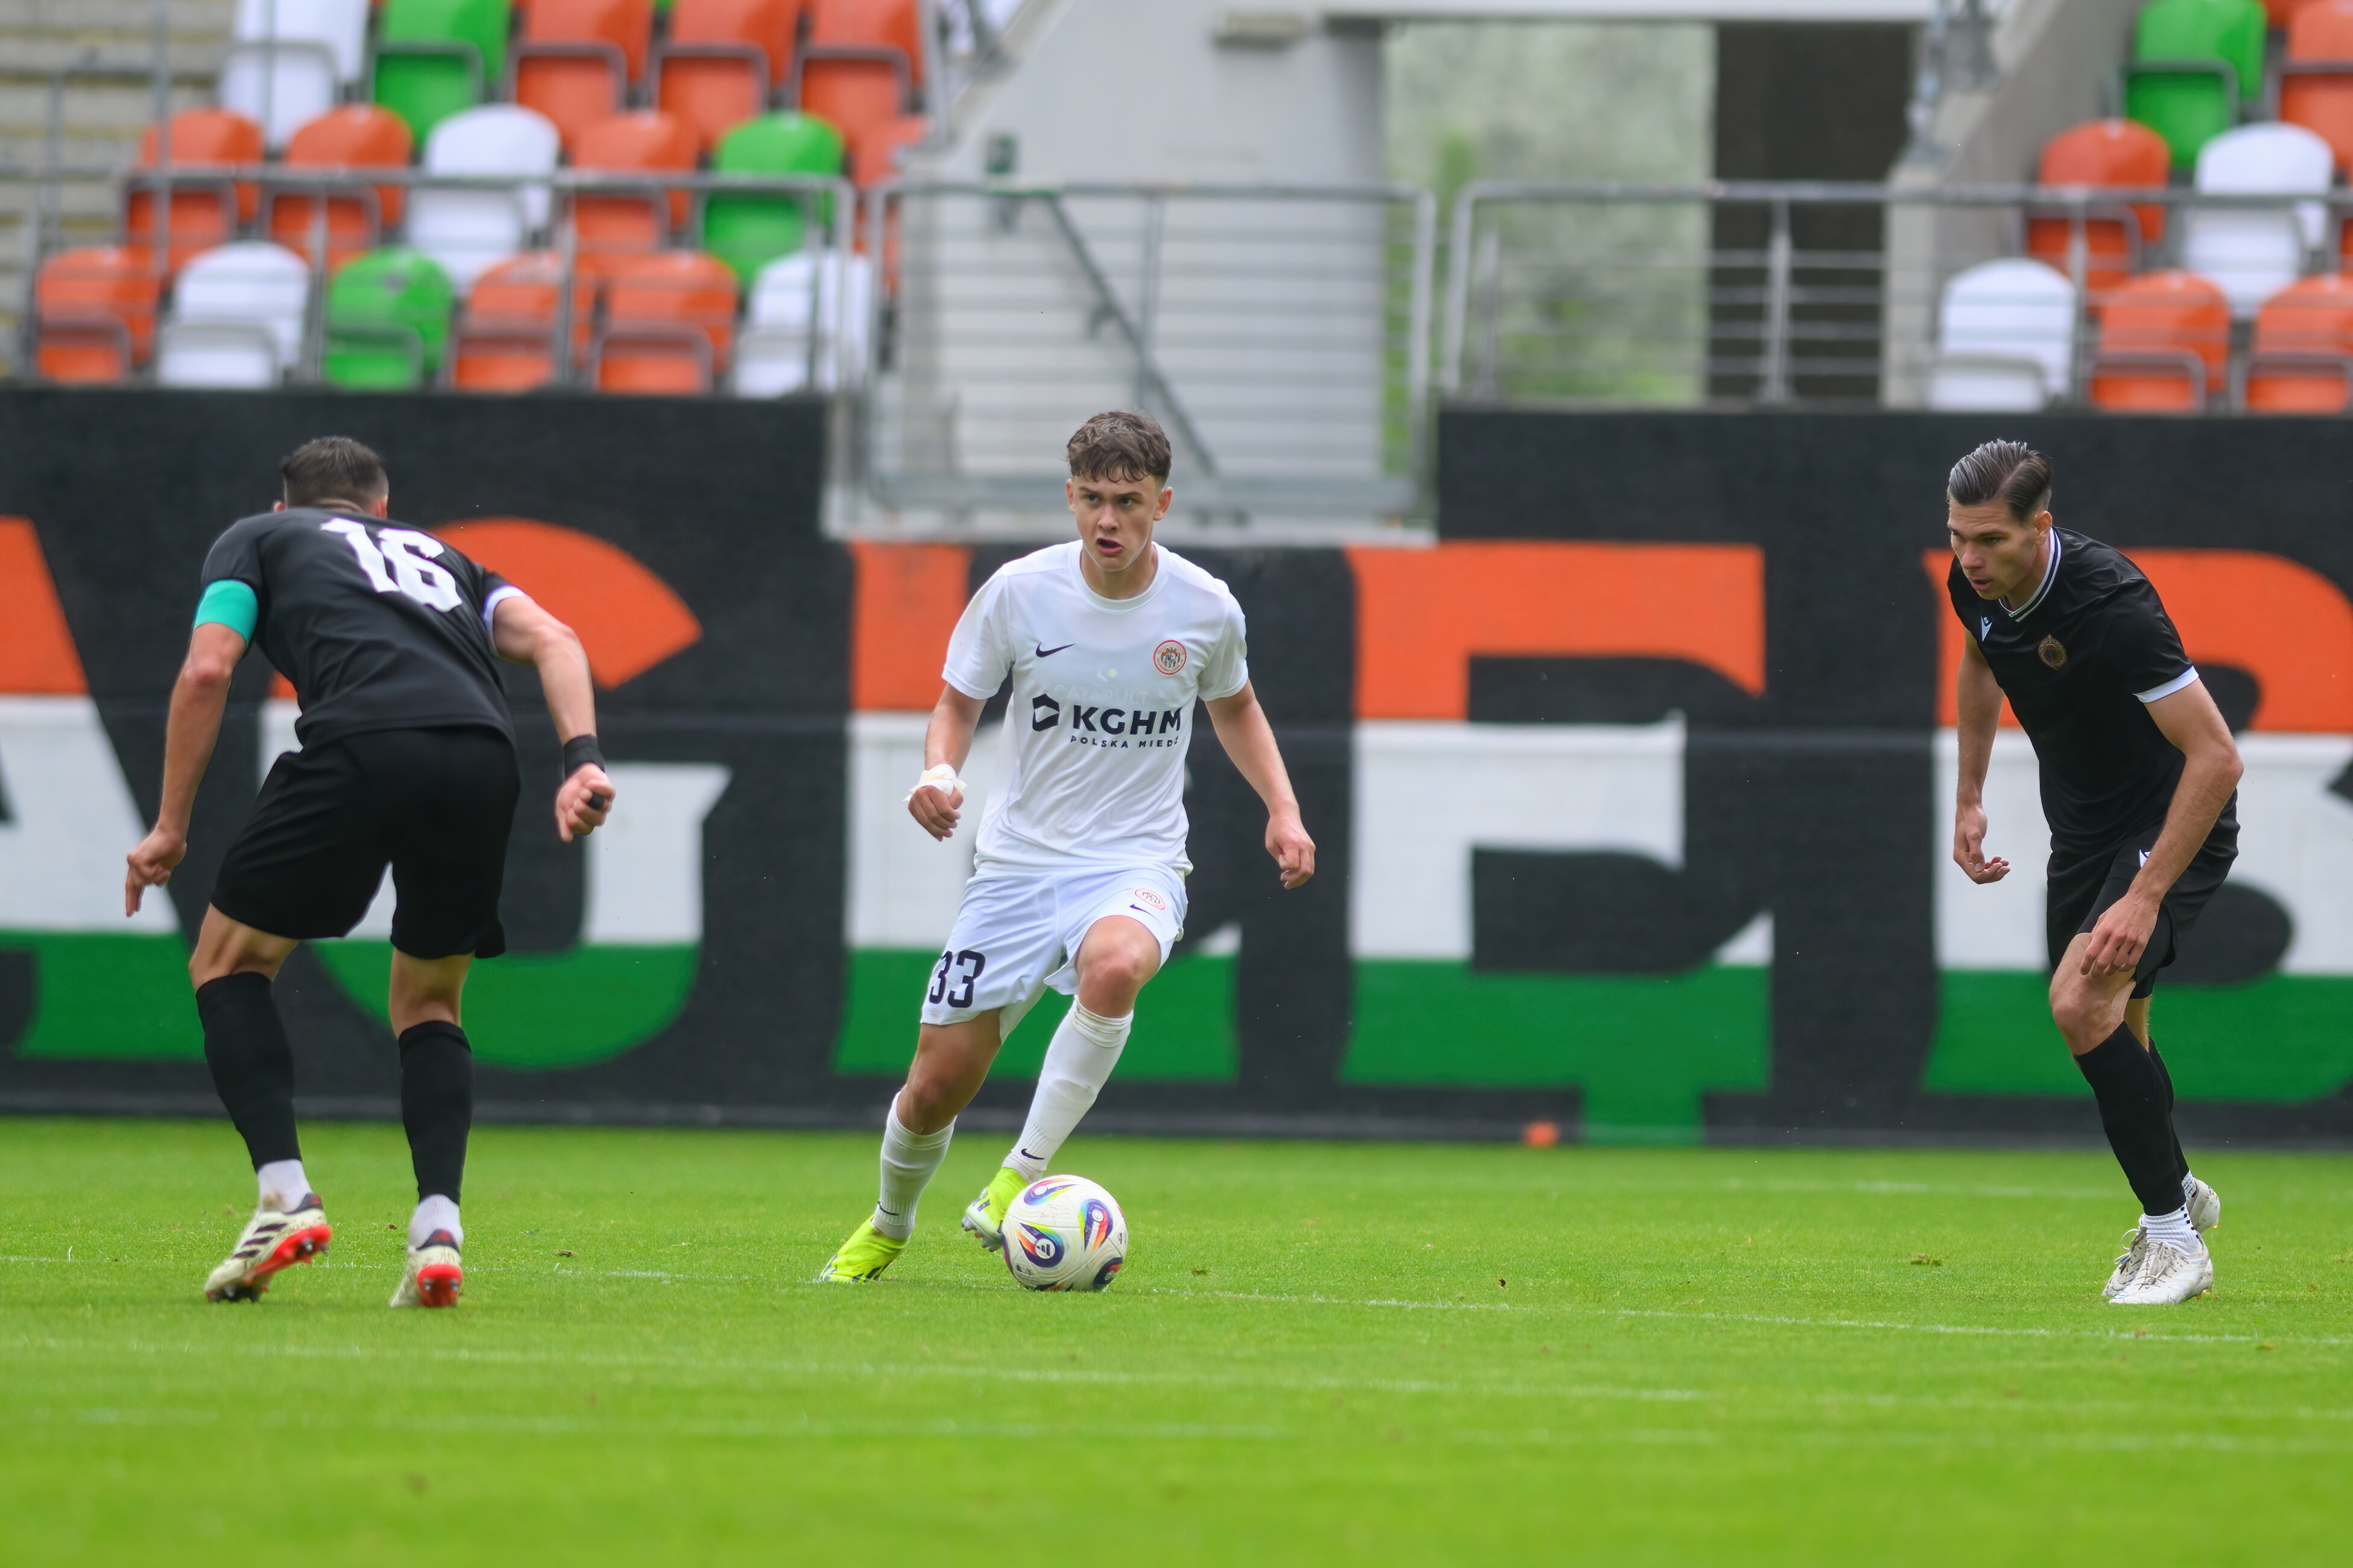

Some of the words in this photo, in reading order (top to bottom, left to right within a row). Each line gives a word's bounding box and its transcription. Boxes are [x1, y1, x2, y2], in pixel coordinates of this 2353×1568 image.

[320, 517, 463, 612] 16
[1070, 735, 1128, 748] POLSKA
[1073, 705, 1183, 735] KGHM
[929, 950, 986, 1007] 33
